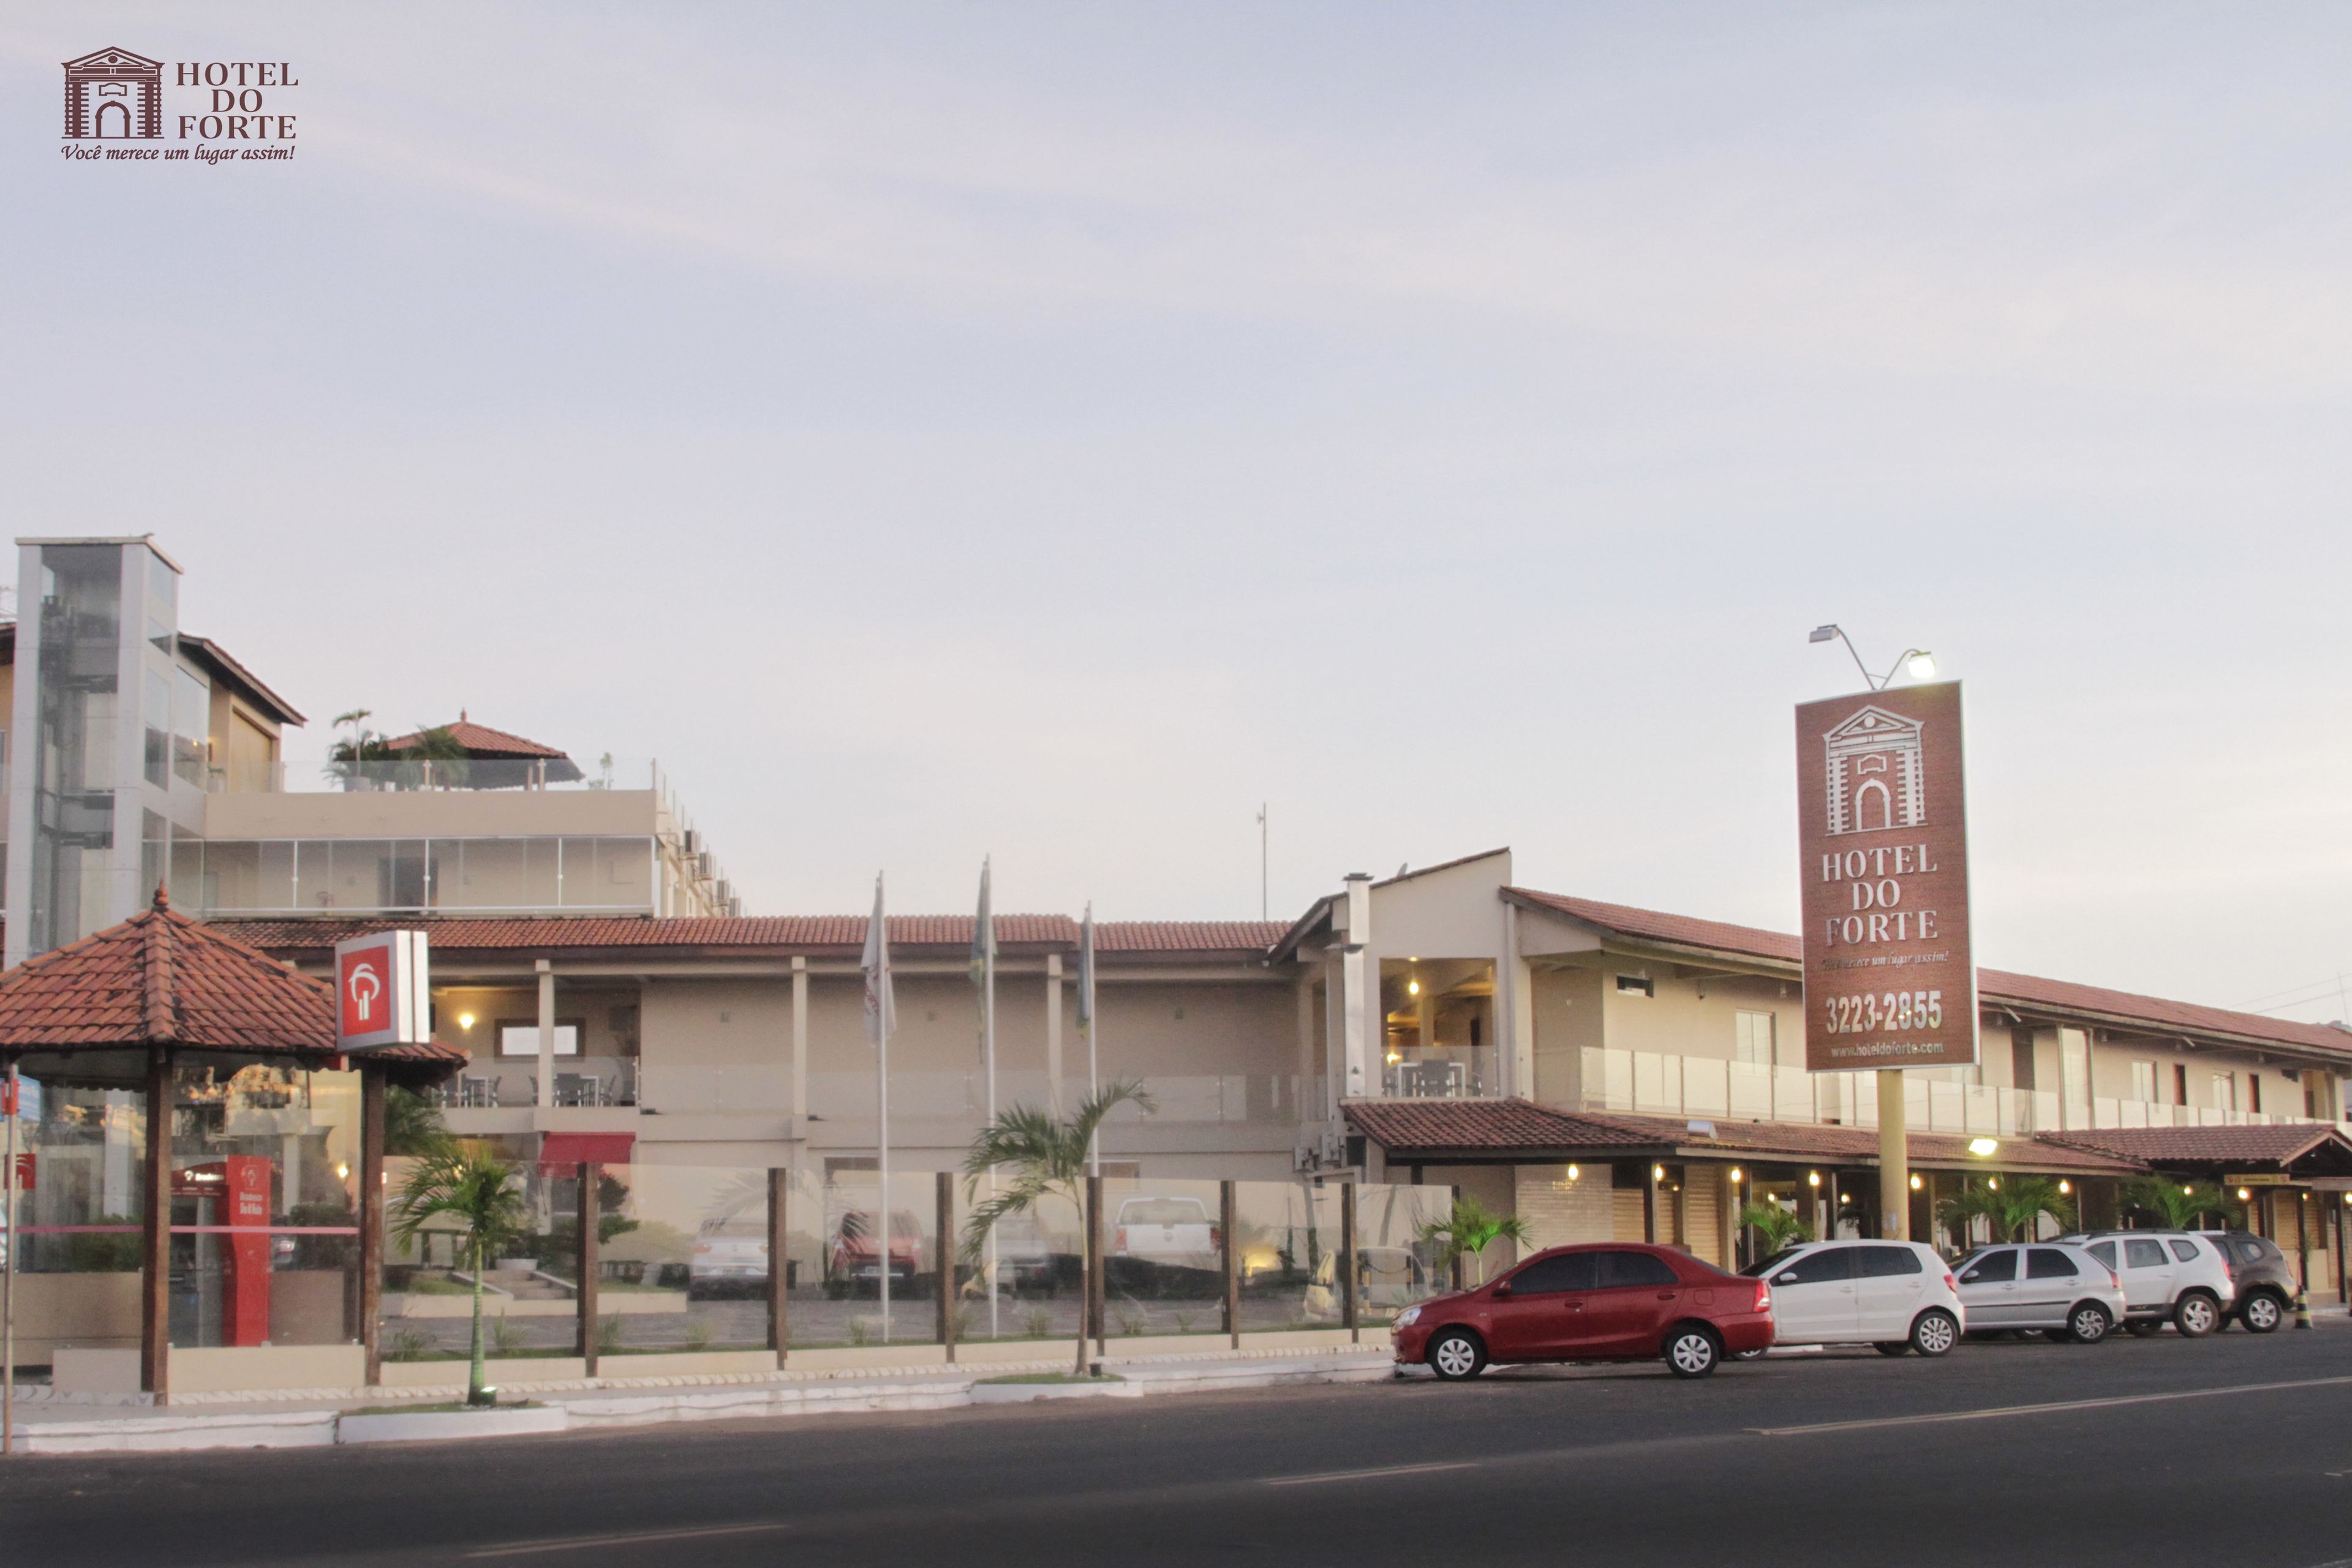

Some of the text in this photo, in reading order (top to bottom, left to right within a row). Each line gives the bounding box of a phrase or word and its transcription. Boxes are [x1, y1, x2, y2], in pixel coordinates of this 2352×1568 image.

[1822, 844, 1938, 882] HOTEL
[1852, 879, 1901, 911] DO
[1825, 911, 1939, 946] FORTE
[1872, 956, 1887, 966] um
[1915, 951, 1949, 963] assim!
[1826, 990, 1942, 1034] 3223-2855
[1831, 1042, 1944, 1057] www.hoteldoforte.com
